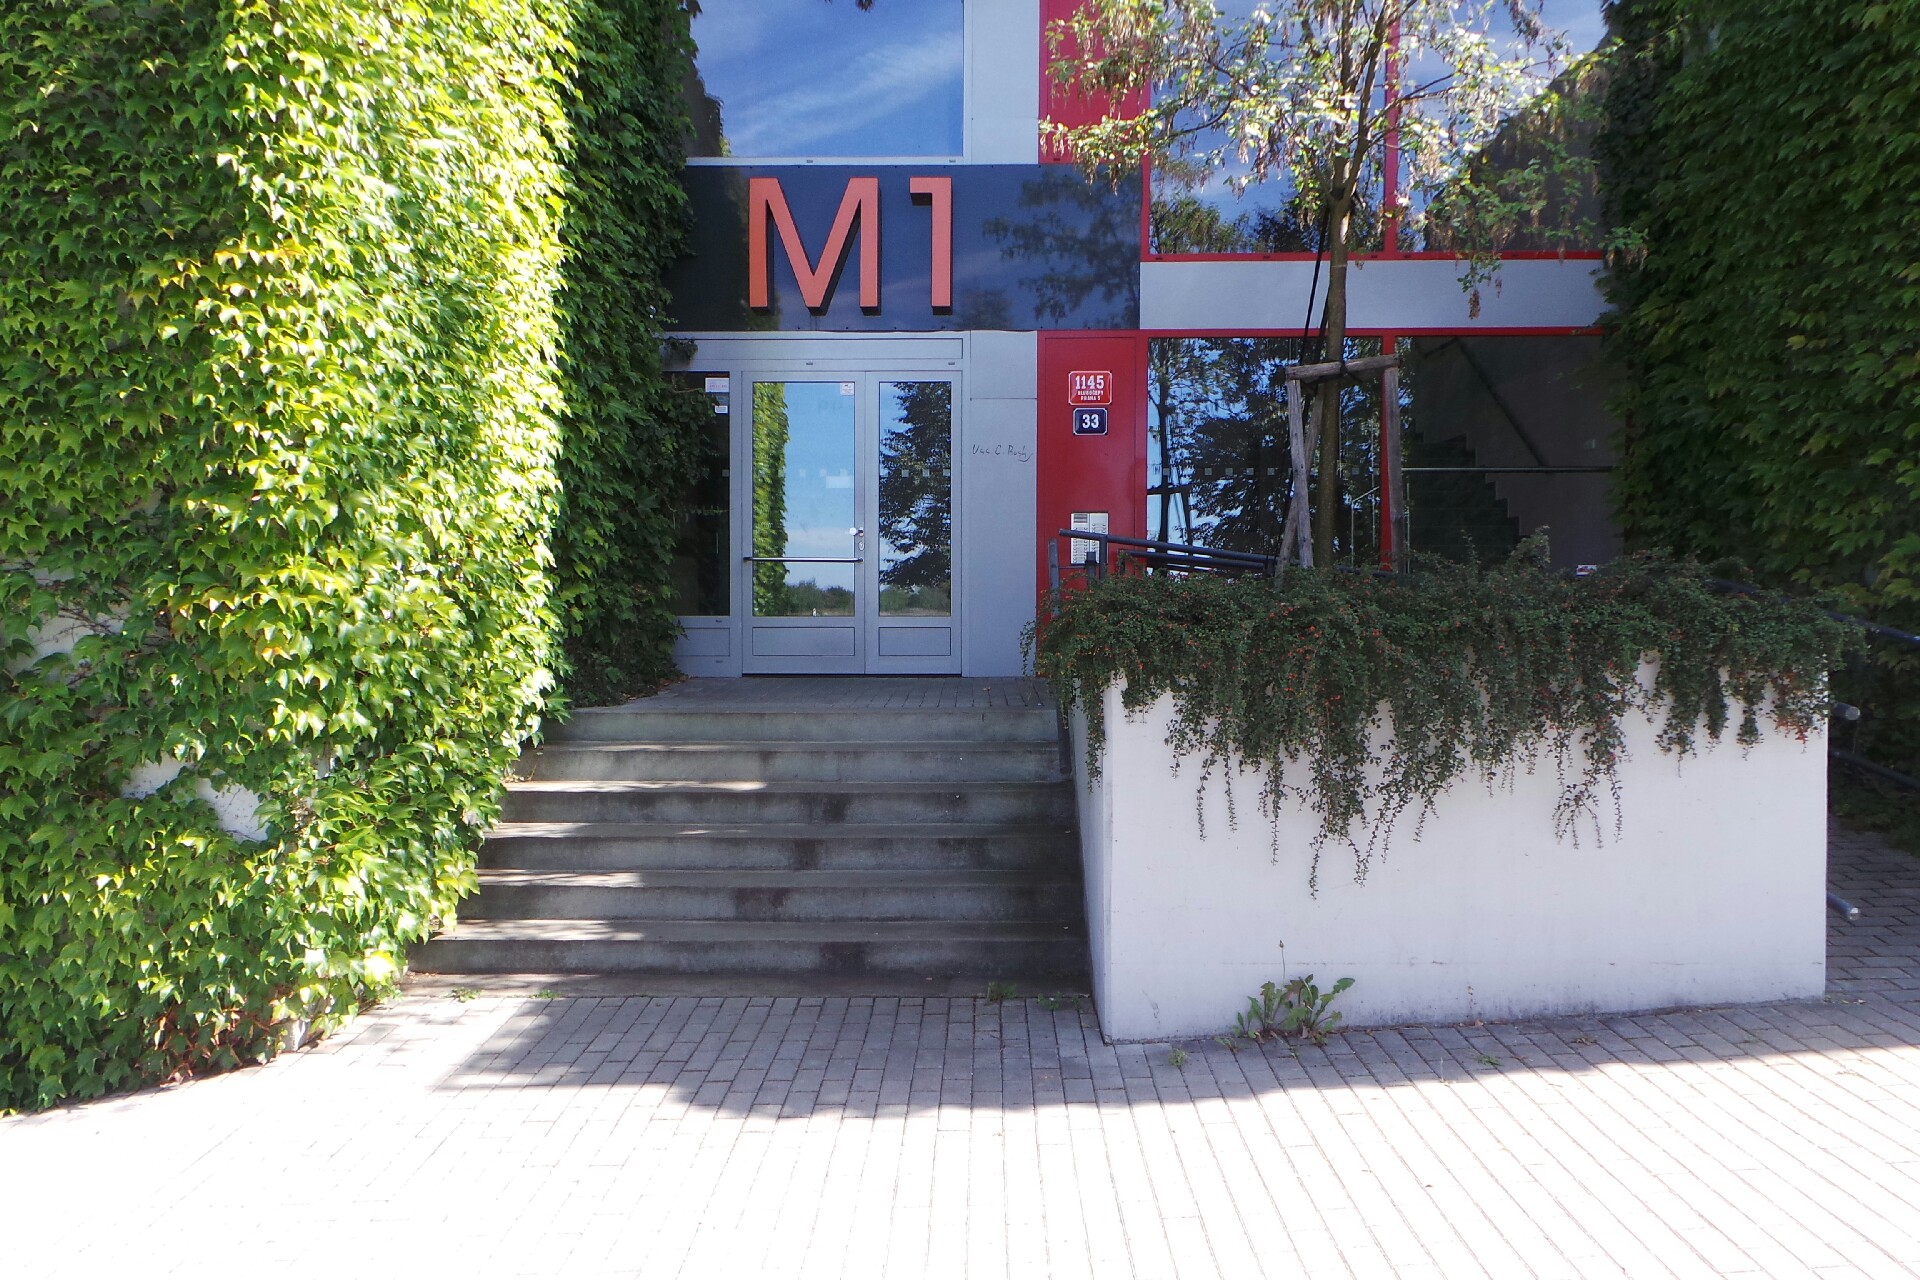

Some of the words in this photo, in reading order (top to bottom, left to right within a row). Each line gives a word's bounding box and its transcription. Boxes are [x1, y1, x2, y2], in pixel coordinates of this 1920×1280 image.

[748, 176, 953, 309] M1
[1075, 375, 1104, 390] 1145
[1082, 413, 1099, 429] 33
